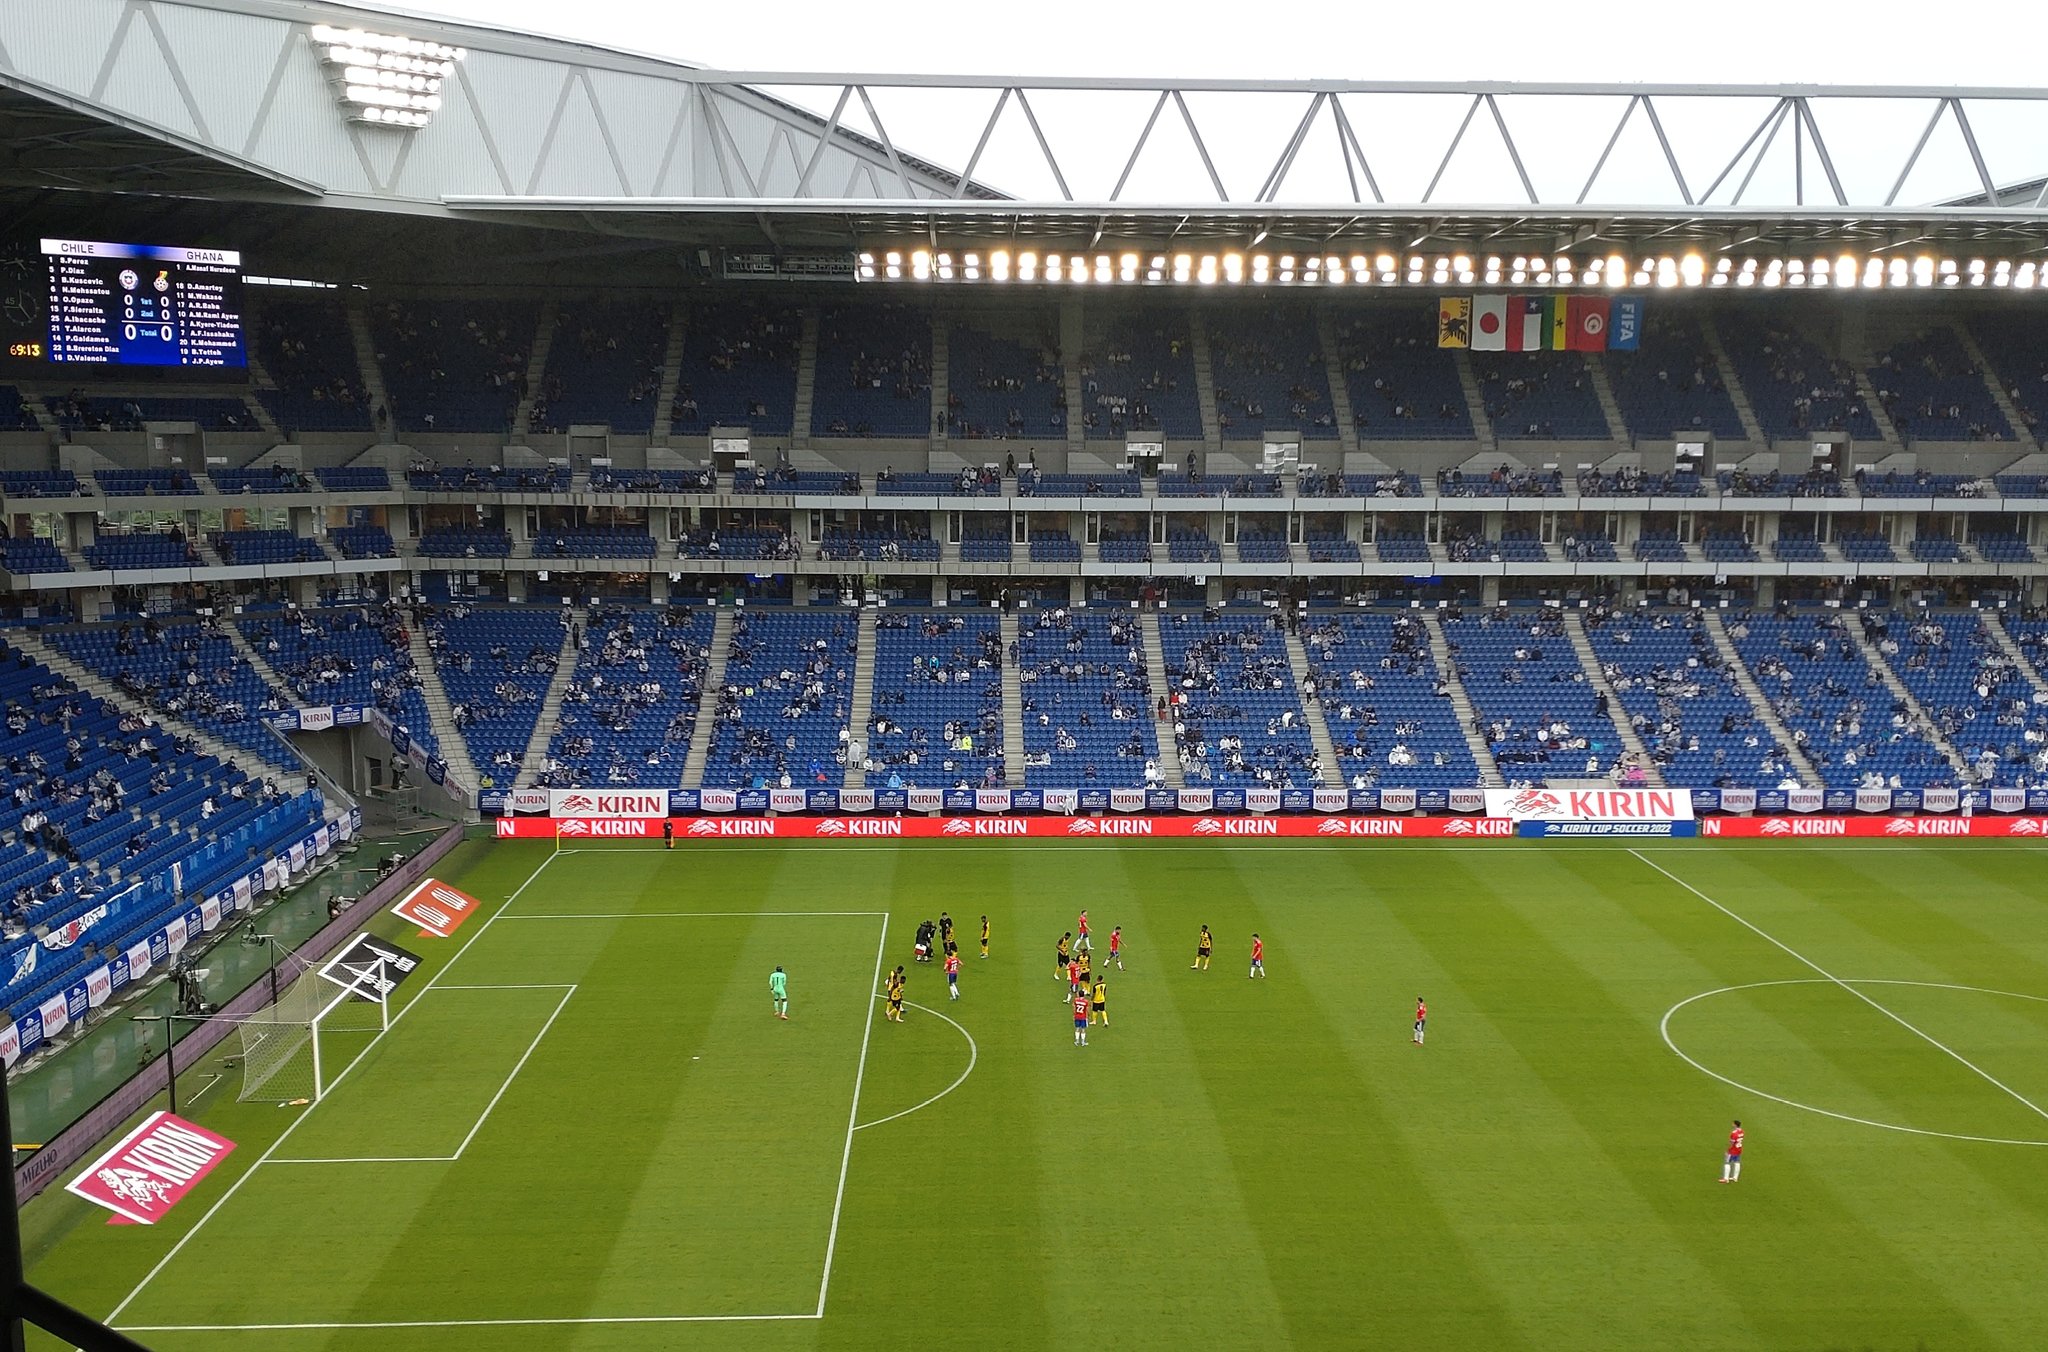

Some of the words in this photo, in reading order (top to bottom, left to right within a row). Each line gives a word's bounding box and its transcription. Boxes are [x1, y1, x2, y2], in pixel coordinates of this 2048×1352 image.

[60, 243, 94, 254] CHILE
[186, 251, 224, 262] GHANA
[123, 294, 133, 306] 0
[160, 296, 169, 307] 0
[124, 308, 134, 319] 0
[161, 309, 170, 320] 0
[1619, 303, 1635, 343] FIFA
[124, 323, 137, 341] 0
[140, 329, 158, 337] Total
[160, 325, 173, 342] 0
[9, 344, 41, 357] 69:13
[302, 712, 332, 723] KIRIN
[515, 794, 547, 805] KIRIN
[598, 796, 661, 813] KIRIN
[703, 794, 735, 805] KIRIN
[772, 794, 803, 804] KIRIN
[842, 794, 873, 804] KIRIN
[910, 794, 941, 804] KIRIN
[978, 794, 1008, 804] KIRIN
[1113, 794, 1143, 804] KIRIN
[1180, 794, 1211, 804] KIRIN
[1248, 794, 1278, 804] KIRIN
[1315, 794, 1345, 804] KIRIN
[1383, 794, 1413, 804] KIRIN
[1451, 794, 1482, 804] KIRIN
[1569, 791, 1675, 817] KIRIN
[1723, 795, 1753, 804] KIRIN
[1791, 794, 1822, 804] KIRIN
[1858, 794, 1889, 804] KIRIN
[1926, 794, 1956, 804] KIRIN
[1993, 794, 2023, 804] KIRIN
[591, 820, 645, 835] KIRIN
[721, 820, 774, 835] KIRIN
[849, 820, 901, 835] KIRIN
[975, 820, 1027, 835] KIRIN
[1100, 819, 1152, 834] KIRIN
[1225, 819, 1277, 834] KIRIN
[1350, 820, 1403, 834] KIRIN
[1560, 824, 1592, 833] KIRIN
[1591, 824, 1612, 833] CUP
[1612, 824, 1649, 833] SOCCER
[1649, 824, 1672, 833] 2022
[1792, 820, 1845, 834] KIRIN
[1917, 820, 1970, 834] KIRIN
[132, 950, 149, 971] KIRIN
[89, 975, 109, 998] KIRIN
[44, 1003, 66, 1027] KIRIN
[122, 1120, 224, 1187] KIRIN
[21, 1148, 58, 1187] MIZUHO
